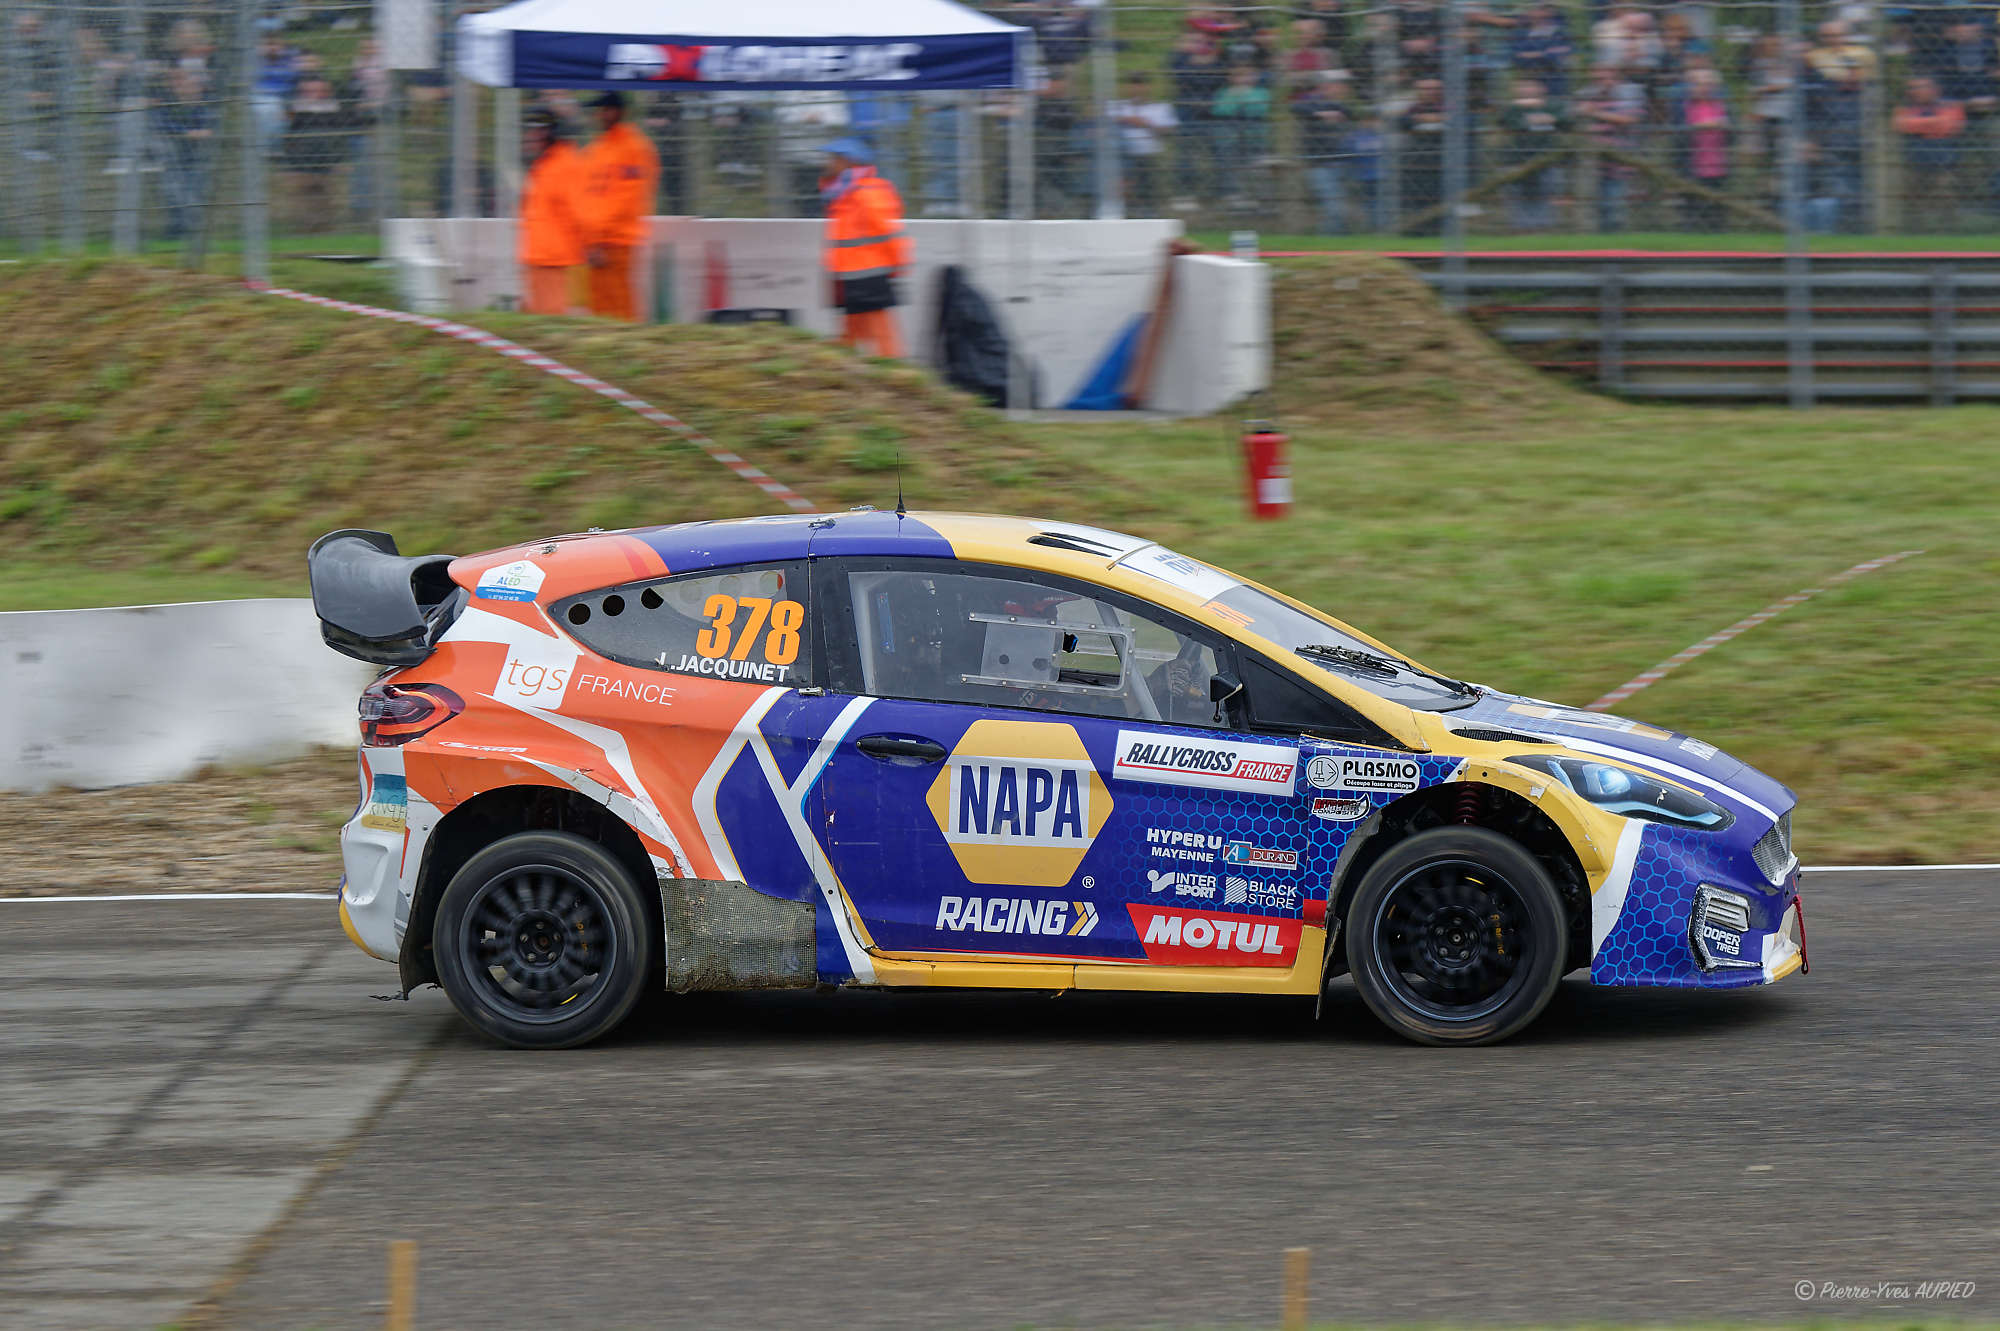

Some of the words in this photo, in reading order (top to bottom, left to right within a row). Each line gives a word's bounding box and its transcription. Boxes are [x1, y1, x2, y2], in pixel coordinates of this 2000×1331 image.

[695, 593, 805, 665] 378
[507, 659, 568, 697] tgs
[576, 674, 678, 706] FRANCE
[1126, 742, 1237, 773] RALLYCROSS
[1236, 763, 1292, 782] FRANCE
[1342, 760, 1417, 778] PLASMO
[958, 765, 1083, 838] NAPA
[1146, 828, 1206, 848] HYPER
[1207, 836, 1223, 849] U
[1151, 846, 1214, 863] MAYENNE
[1253, 850, 1296, 863] DURAND
[1176, 872, 1217, 888] INTER
[1175, 884, 1216, 899] SPORT
[1249, 881, 1297, 898] BLACK
[1247, 894, 1296, 910] STORE
[936, 896, 1069, 935] RACING
[1144, 914, 1284, 955] MOTUL
[1716, 941, 1740, 956] TIRES
